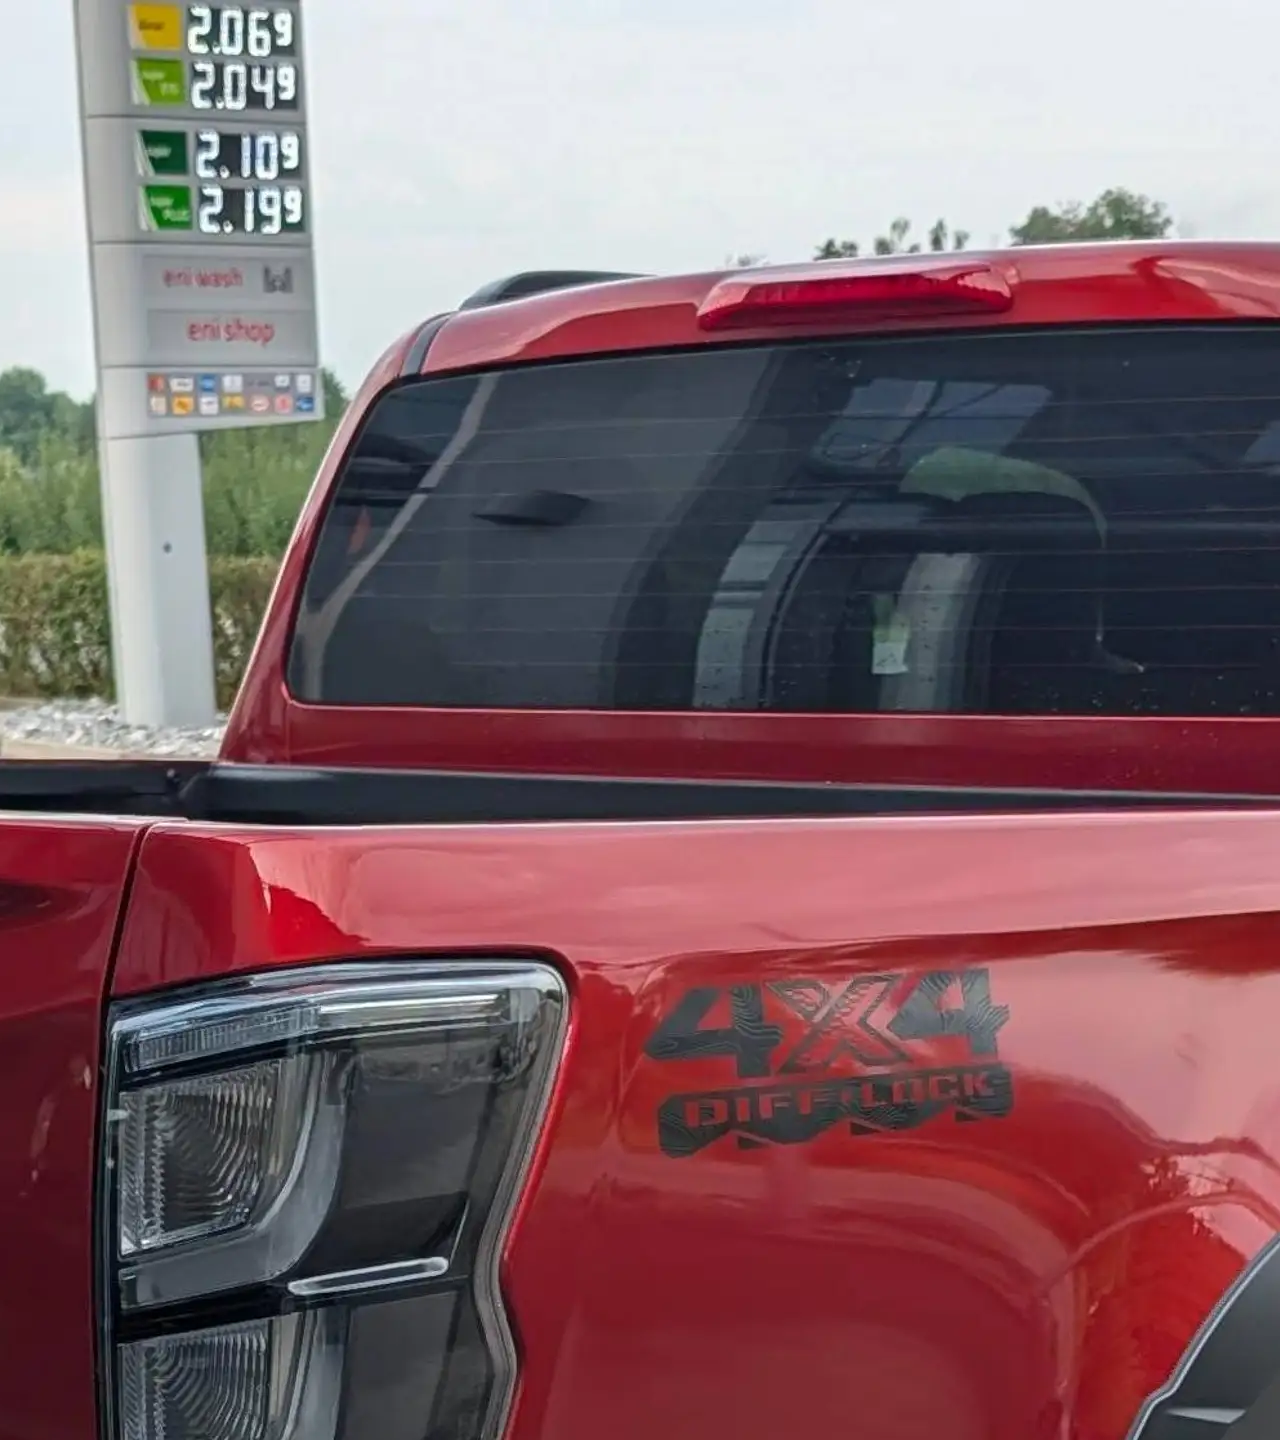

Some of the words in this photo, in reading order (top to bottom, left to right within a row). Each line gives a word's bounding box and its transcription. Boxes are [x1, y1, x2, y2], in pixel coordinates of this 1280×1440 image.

[197, 267, 243, 288] wash
[187, 318, 219, 342] eni
[222, 317, 276, 347] shop
